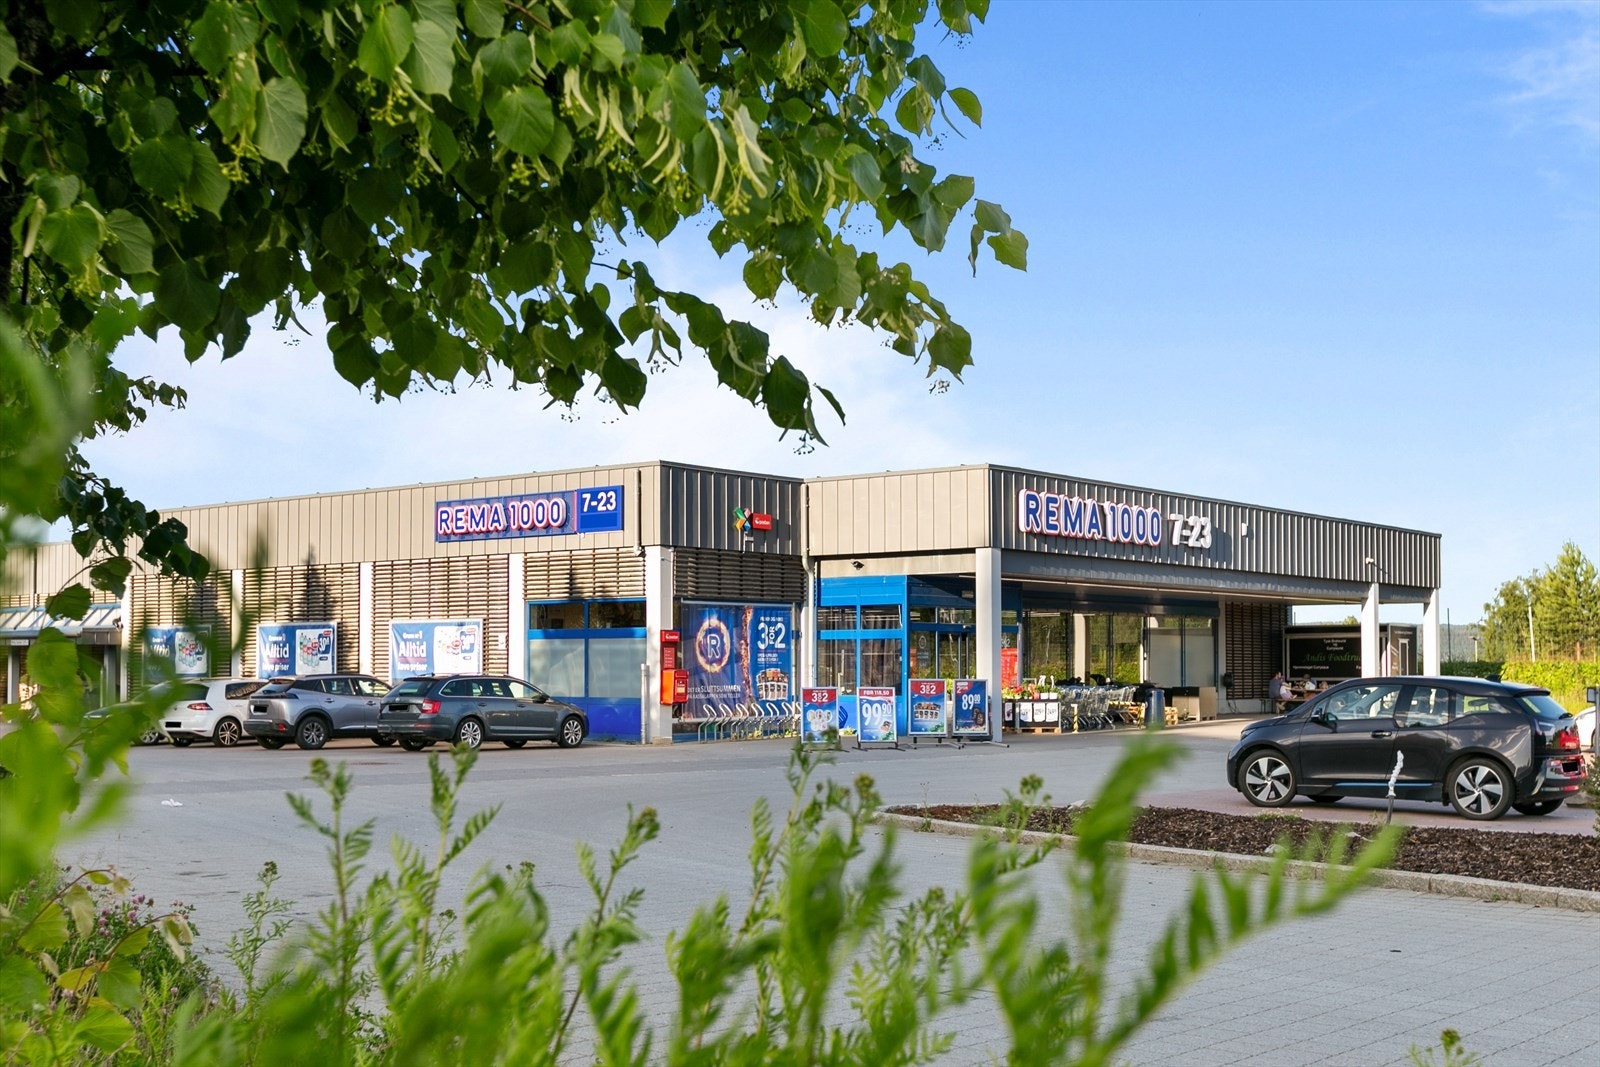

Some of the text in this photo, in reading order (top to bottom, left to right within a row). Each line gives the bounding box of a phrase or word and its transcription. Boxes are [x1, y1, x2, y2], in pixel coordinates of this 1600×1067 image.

[582, 490, 617, 513] 7-23
[437, 497, 567, 535] REMA 1000
[1018, 488, 1163, 547] REMA 1000
[1170, 512, 1212, 549] 7-23
[707, 634, 720, 659] R
[757, 622, 769, 650] 3
[774, 622, 786, 649] 2
[264, 643, 289, 658] Alltid
[398, 641, 427, 658] Alltid
[274, 662, 290, 672] priser
[811, 692, 818, 702] 3
[822, 692, 828, 702] 2
[930, 685, 936, 694] 2
[962, 693, 974, 710] 89
[862, 703, 892, 726] 99 90
